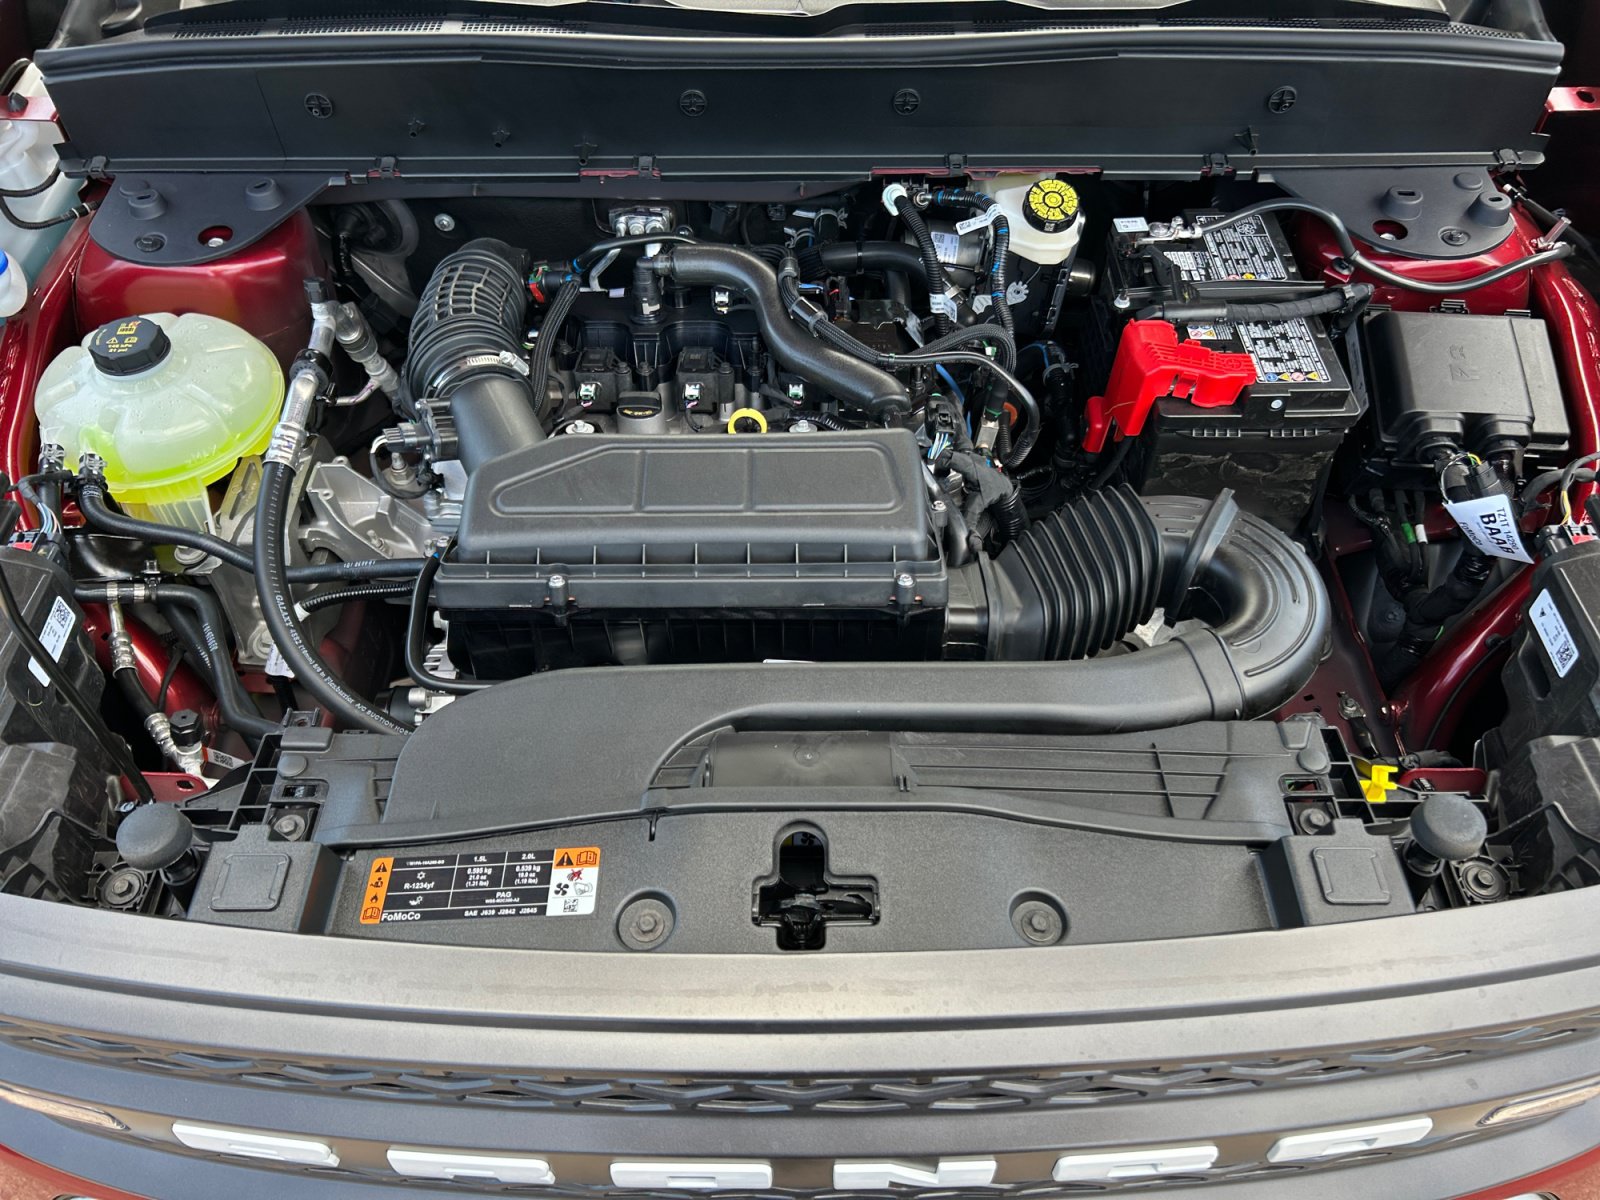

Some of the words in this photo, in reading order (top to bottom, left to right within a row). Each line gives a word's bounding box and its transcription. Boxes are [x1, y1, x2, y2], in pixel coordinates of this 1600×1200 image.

[275, 594, 294, 627] GALAXY
[355, 702, 366, 712] A/C
[366, 710, 394, 729] SUCTION
[484, 867, 493, 875] kg
[532, 864, 541, 873] kg
[403, 881, 435, 890] R-1234yf
[381, 911, 421, 921] FoMoCo
